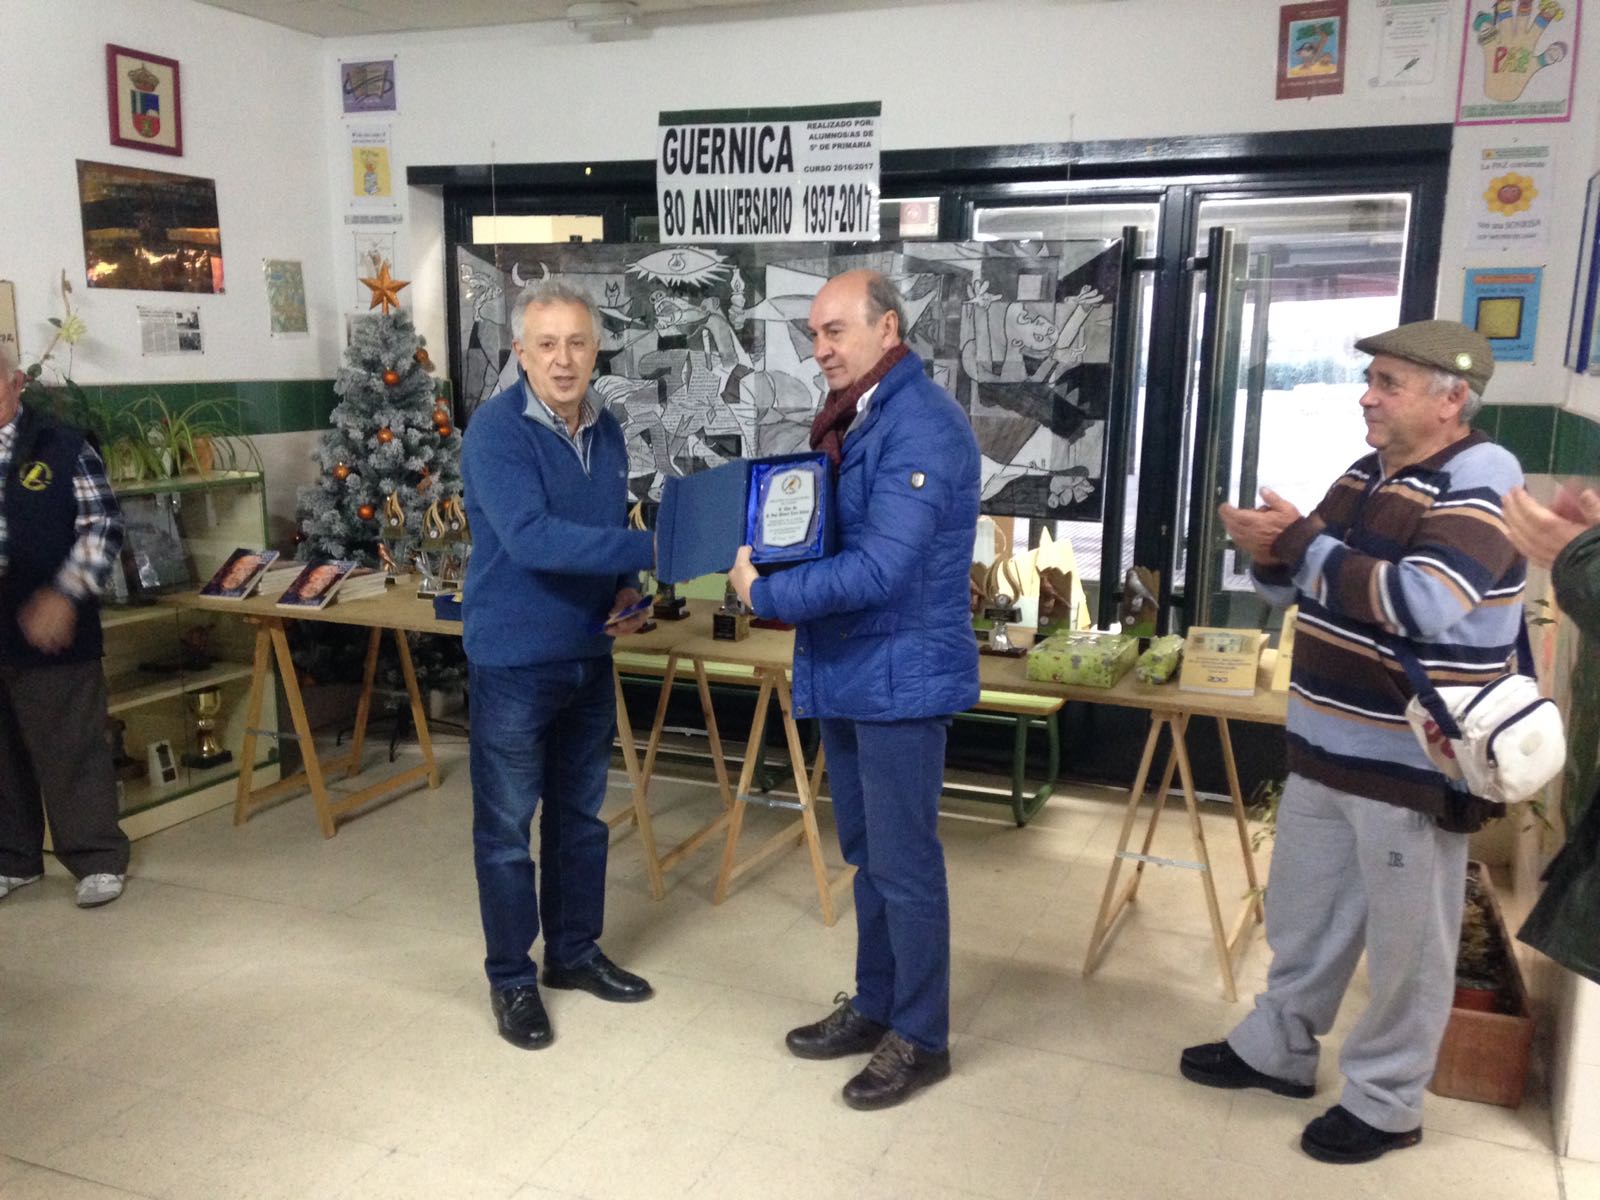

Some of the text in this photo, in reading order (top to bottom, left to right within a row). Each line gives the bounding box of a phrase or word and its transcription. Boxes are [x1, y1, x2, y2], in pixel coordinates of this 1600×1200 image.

[1493, 46, 1530, 73] PAZ
[807, 119, 874, 130] REALIZADO POR:
[863, 129, 873, 137] DE
[662, 125, 794, 175] GUERNICA
[832, 141, 871, 150] PRIMARIA
[803, 162, 873, 173] CURSO 2016/2017
[663, 189, 685, 236] 80
[692, 186, 793, 236] ANIVERSARIO
[803, 183, 872, 234] 1937-2017
